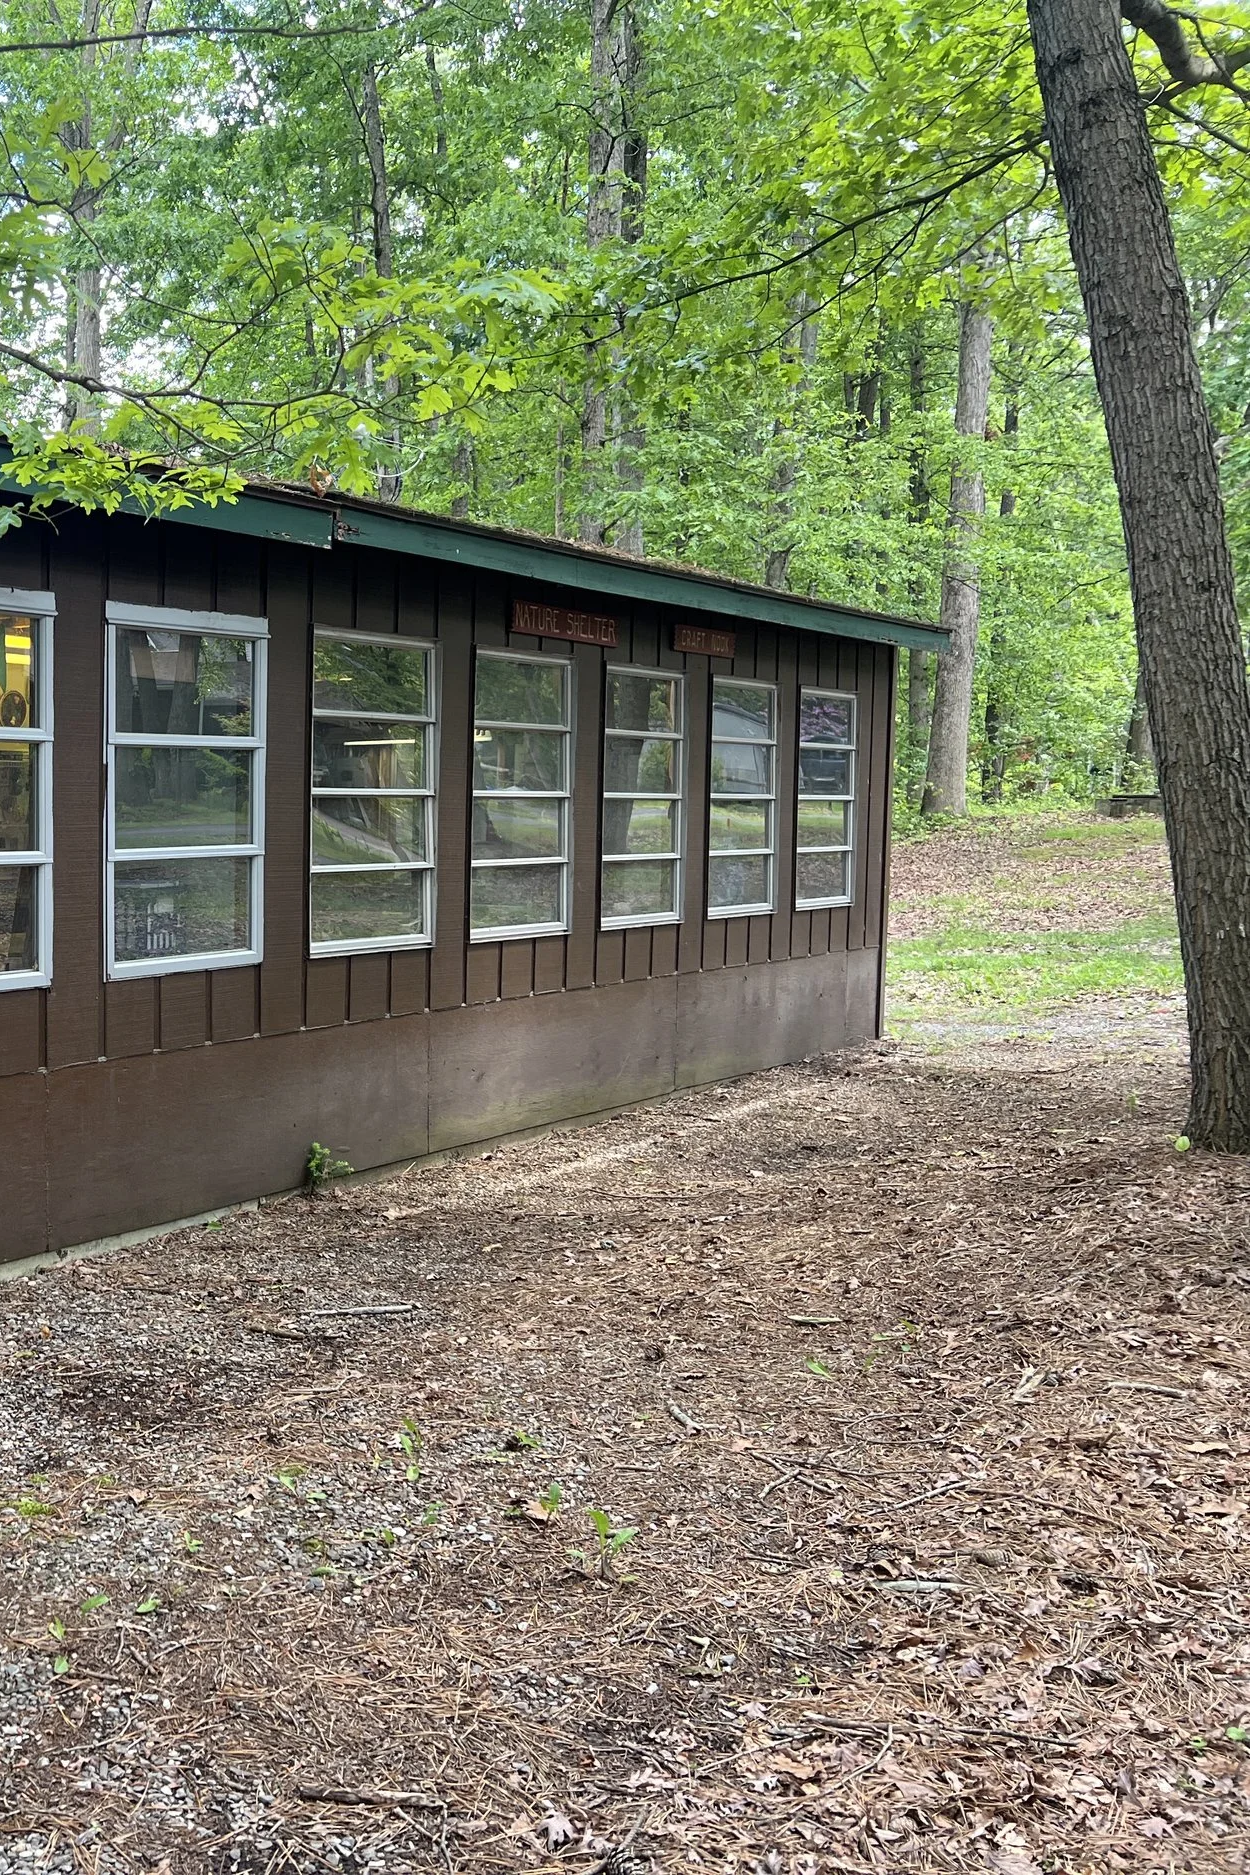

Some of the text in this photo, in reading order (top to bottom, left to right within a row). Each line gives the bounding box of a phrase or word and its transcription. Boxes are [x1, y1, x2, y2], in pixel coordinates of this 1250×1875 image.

[515, 603, 616, 642] NATURE SHELTER
[682, 629, 705, 649] CRAFT
